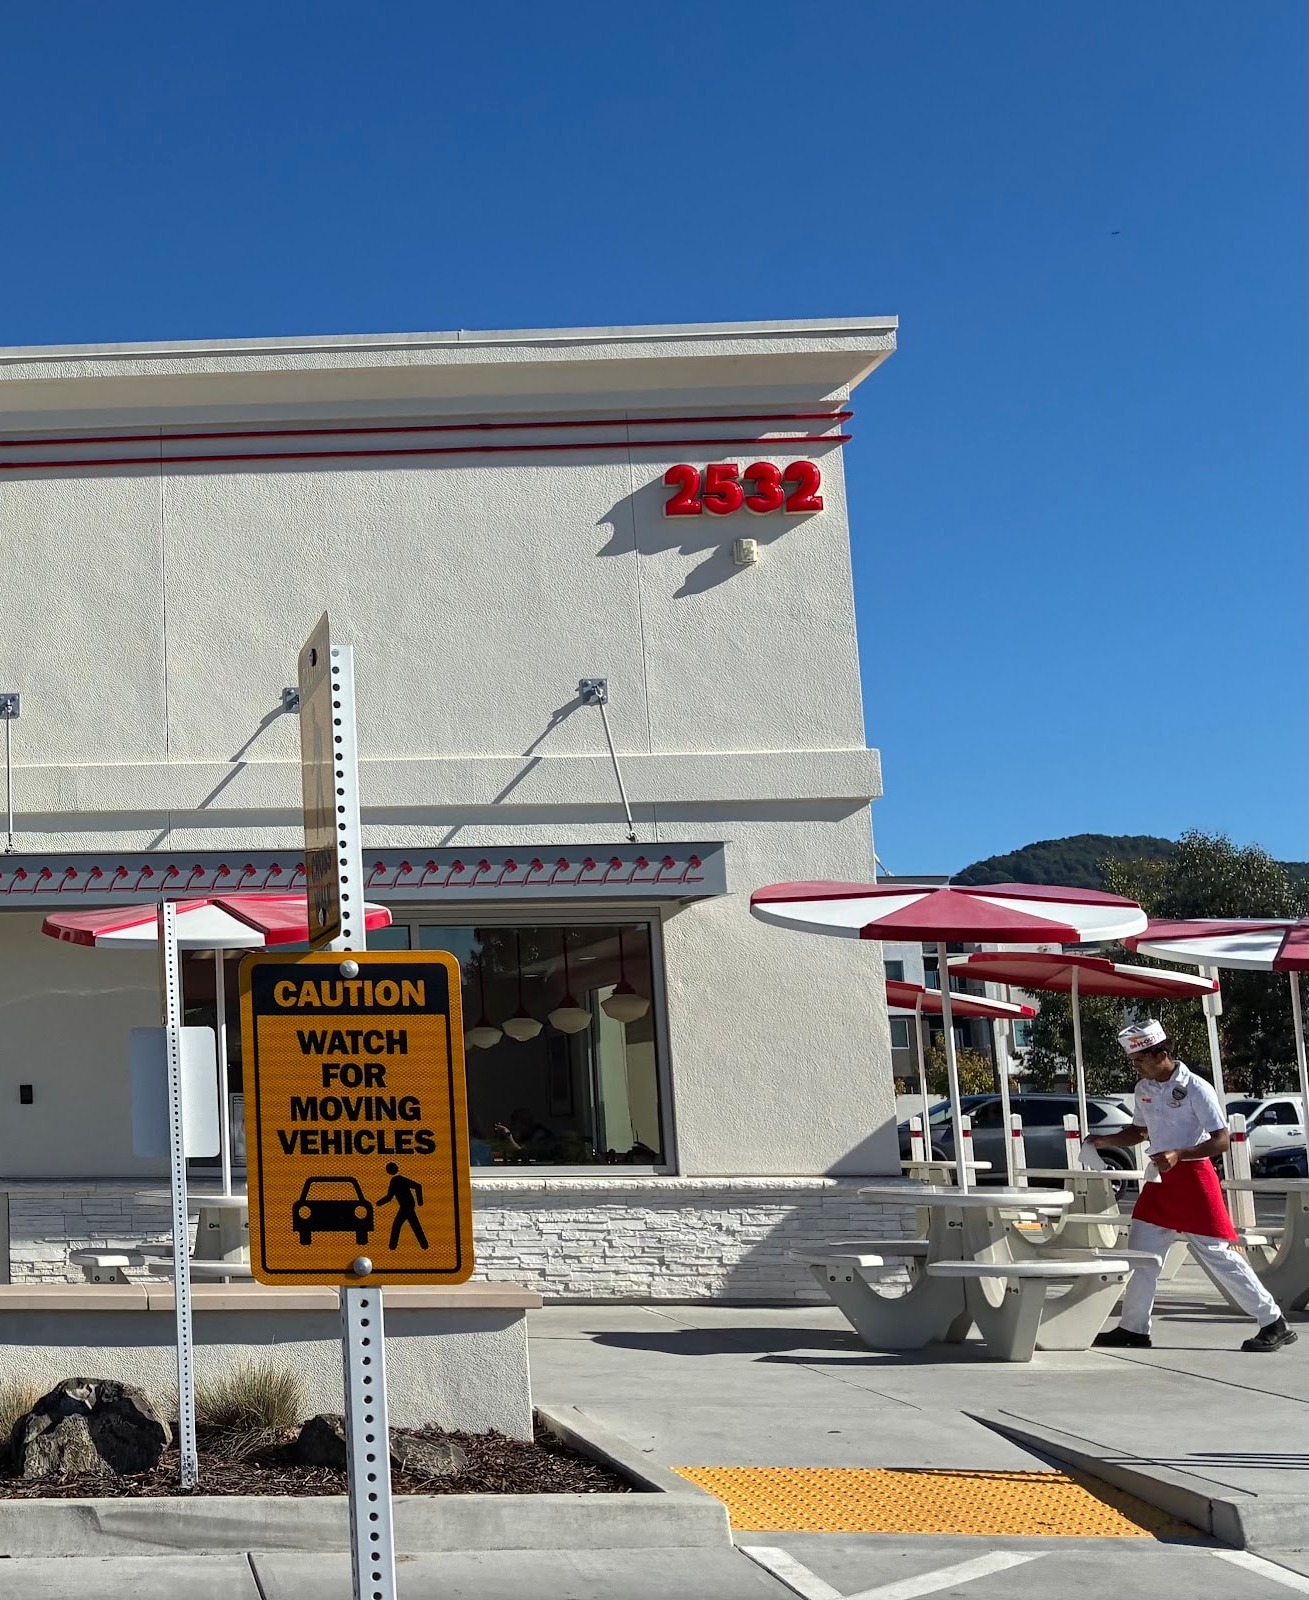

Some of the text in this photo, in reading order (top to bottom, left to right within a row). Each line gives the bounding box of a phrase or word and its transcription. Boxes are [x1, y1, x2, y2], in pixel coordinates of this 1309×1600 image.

[664, 460, 823, 515] 2532
[273, 979, 425, 1008] CAUTION
[297, 1029, 408, 1055] WATCH
[322, 1063, 387, 1088] FOR
[290, 1096, 421, 1122] MOVING
[277, 1129, 436, 1155] VEHICLES
